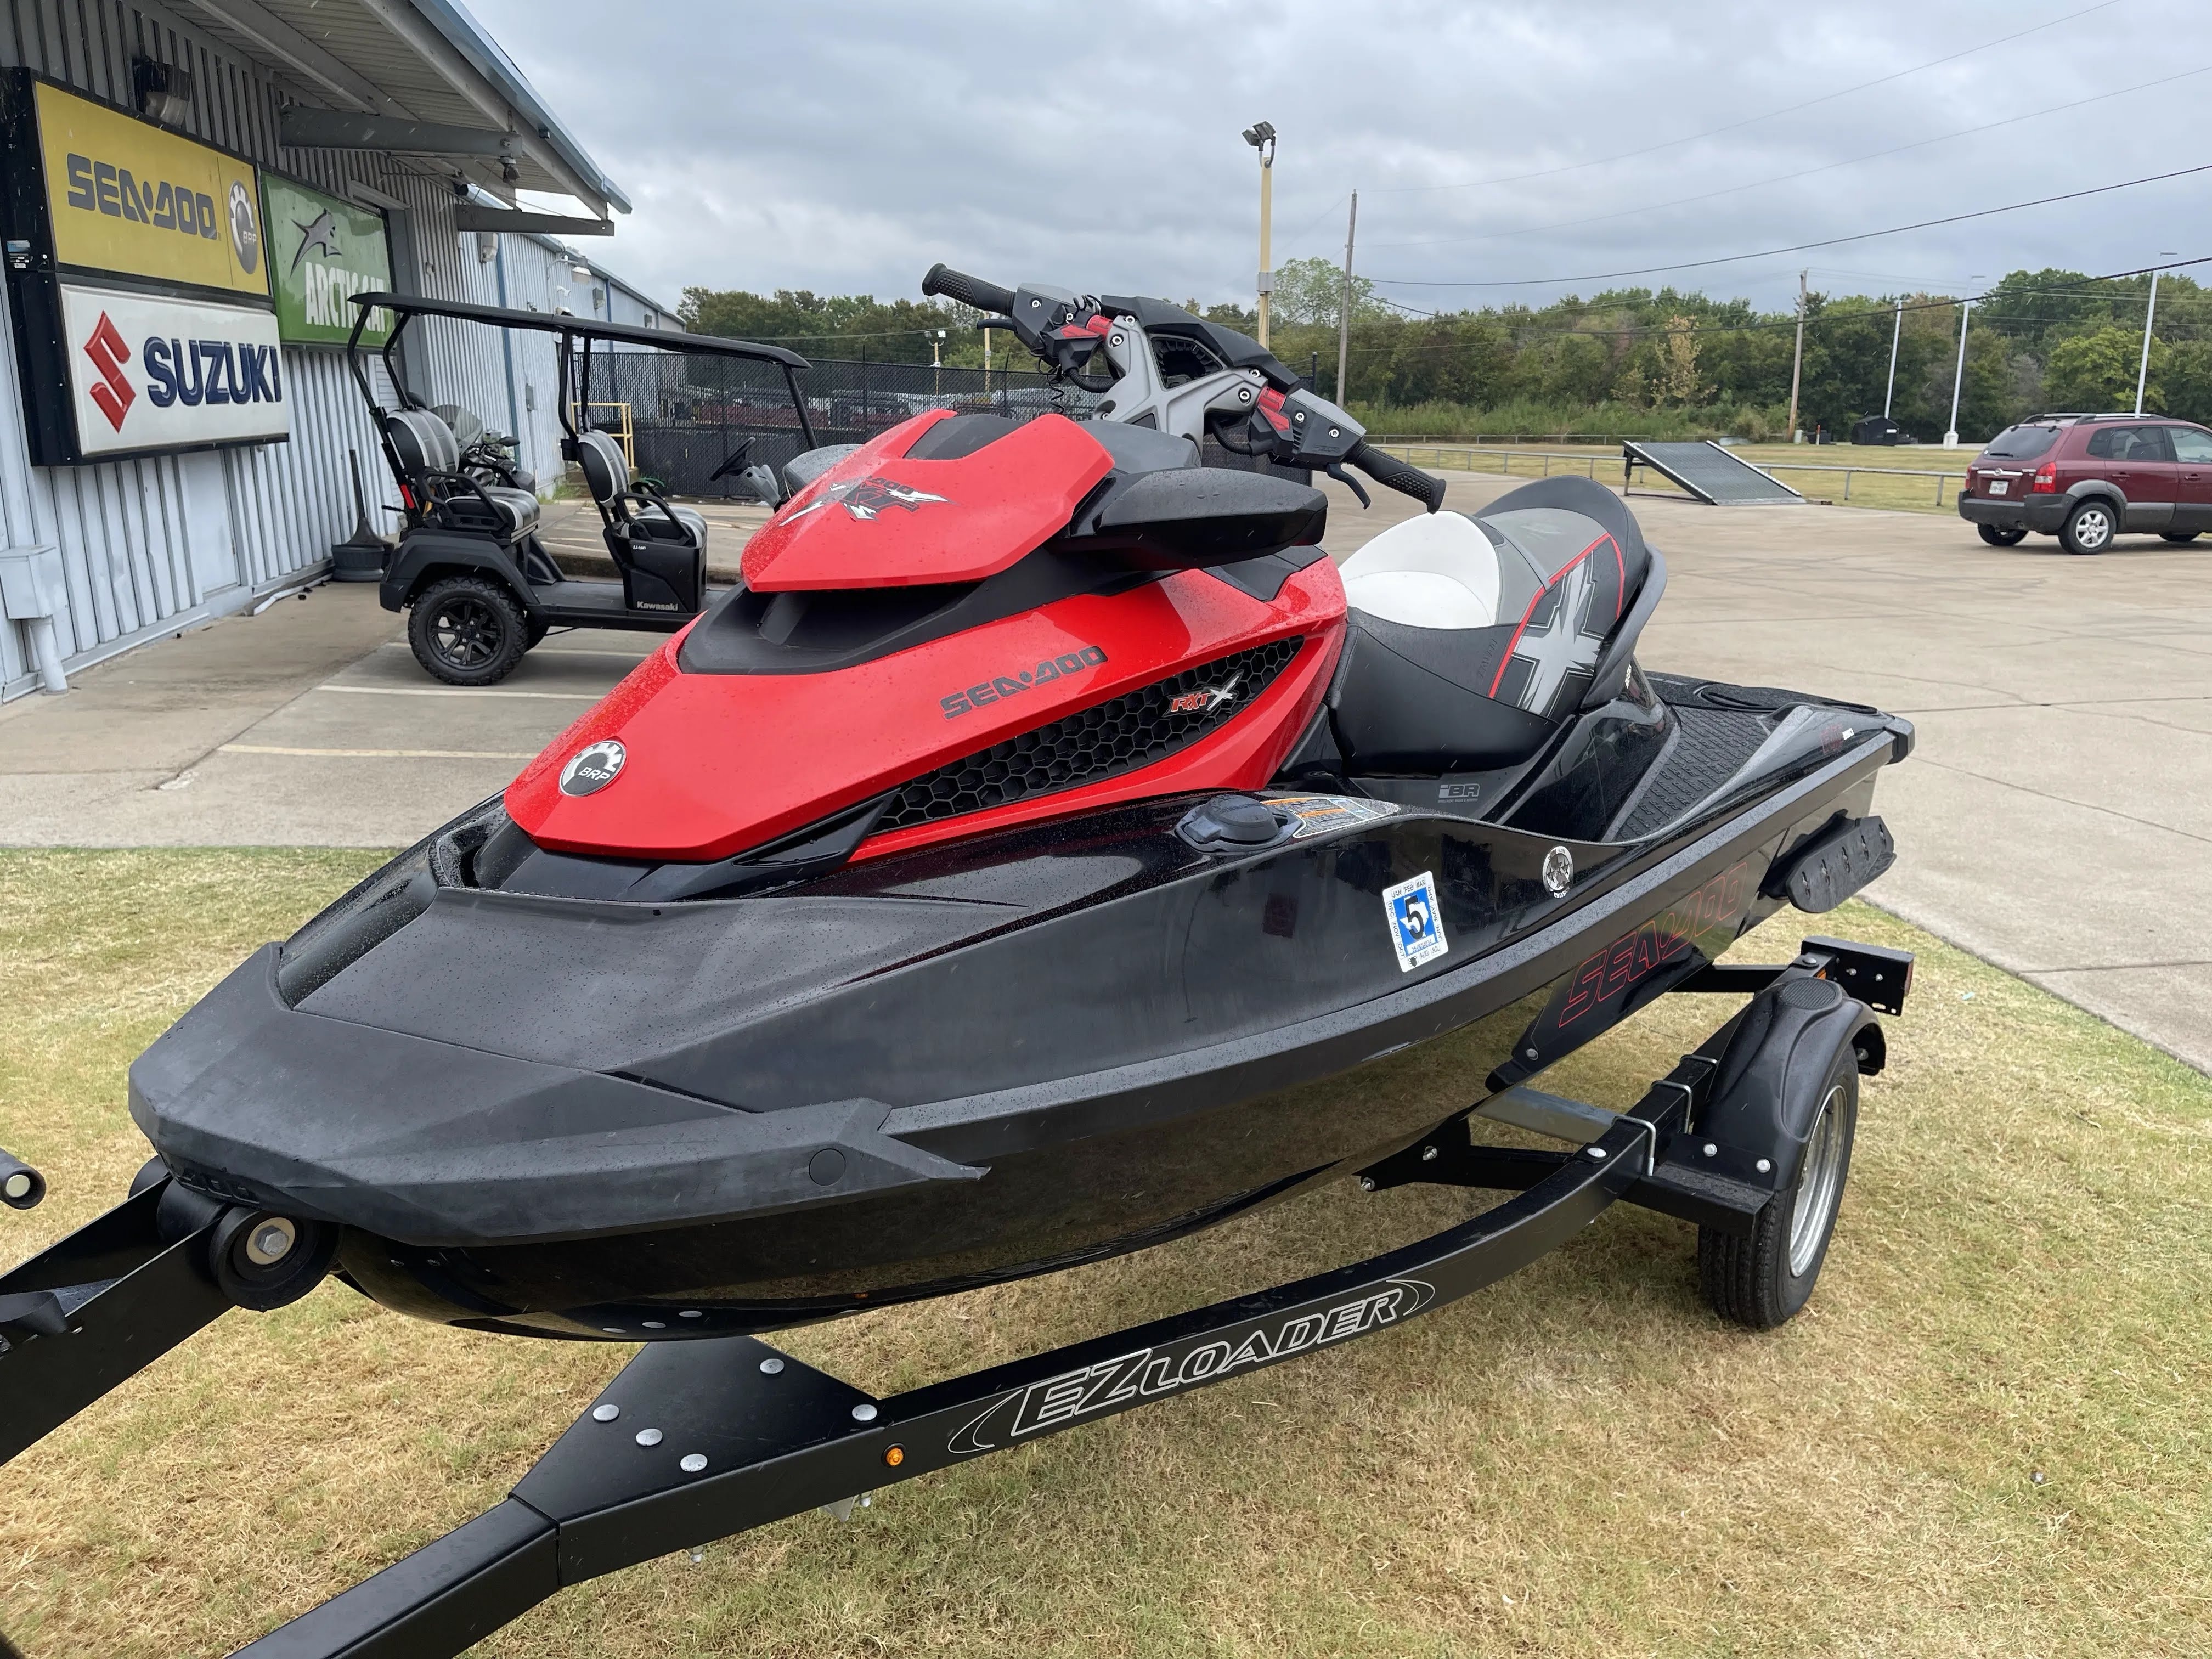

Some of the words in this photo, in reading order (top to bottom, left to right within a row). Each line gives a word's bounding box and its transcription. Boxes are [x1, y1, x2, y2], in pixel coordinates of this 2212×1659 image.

[242, 230, 257, 246] BRP
[305, 261, 359, 329] ARCTIC
[144, 336, 282, 408] SUZUKI
[637, 601, 678, 611] Kawasaki
[578, 766, 611, 781] BRP
[1392, 889, 1402, 898] JAN
[1404, 884, 1414, 893] FEB
[1416, 879, 1425, 888] MAR
[1404, 895, 1424, 940] 5
[1420, 950, 1429, 958] AUG
[1431, 945, 1440, 954] JUL
